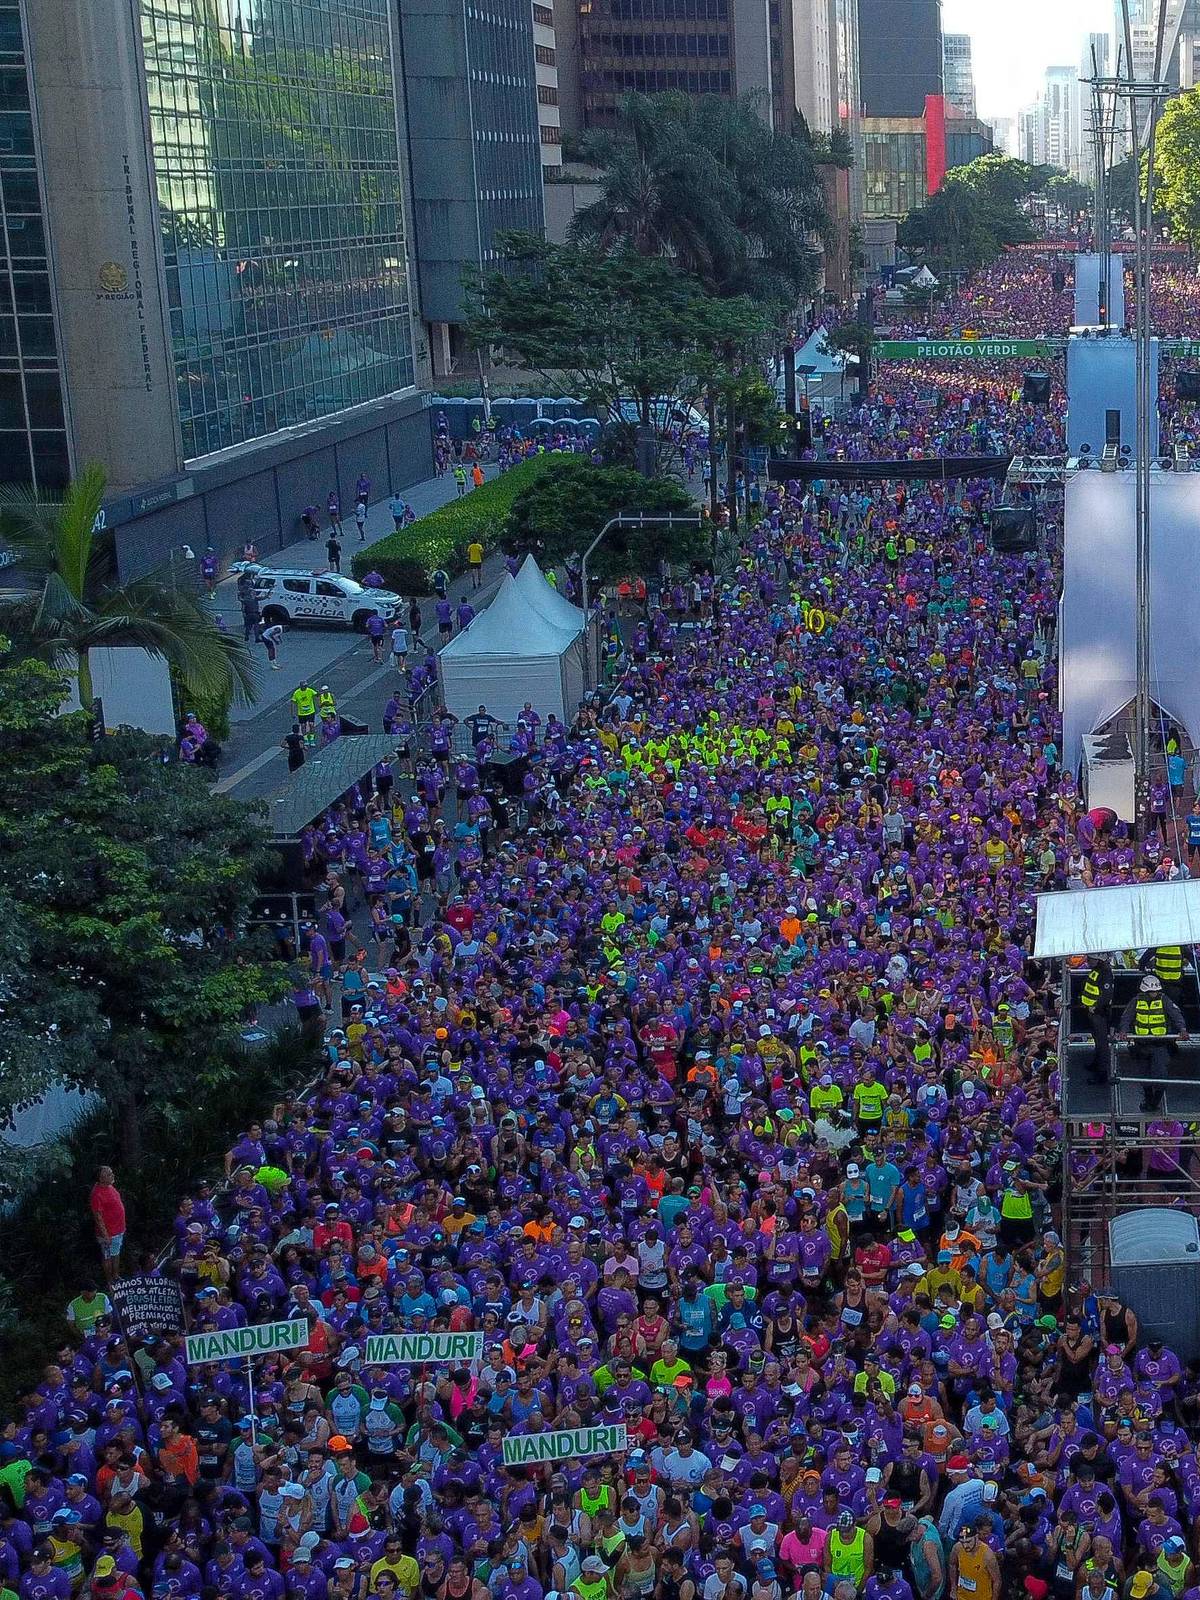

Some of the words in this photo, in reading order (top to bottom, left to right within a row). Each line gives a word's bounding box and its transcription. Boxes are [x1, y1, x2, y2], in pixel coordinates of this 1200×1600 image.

[122, 154, 135, 235] TRIBUNAL
[130, 240, 145, 320] REGIONAL
[139, 324, 152, 392] FEDERAL
[104, 293, 134, 301] REGIÃO
[917, 344, 974, 356] PELOTÃO
[977, 344, 1018, 356] VERDE
[112, 1277, 142, 1291] VAMOS
[113, 1288, 135, 1300] MAIS
[136, 1287, 147, 1295] OS
[188, 1322, 299, 1361] MANDURI
[366, 1335, 475, 1361] MANDURI
[503, 1426, 617, 1464] MANDURI
[618, 1427, 625, 1442] SP
